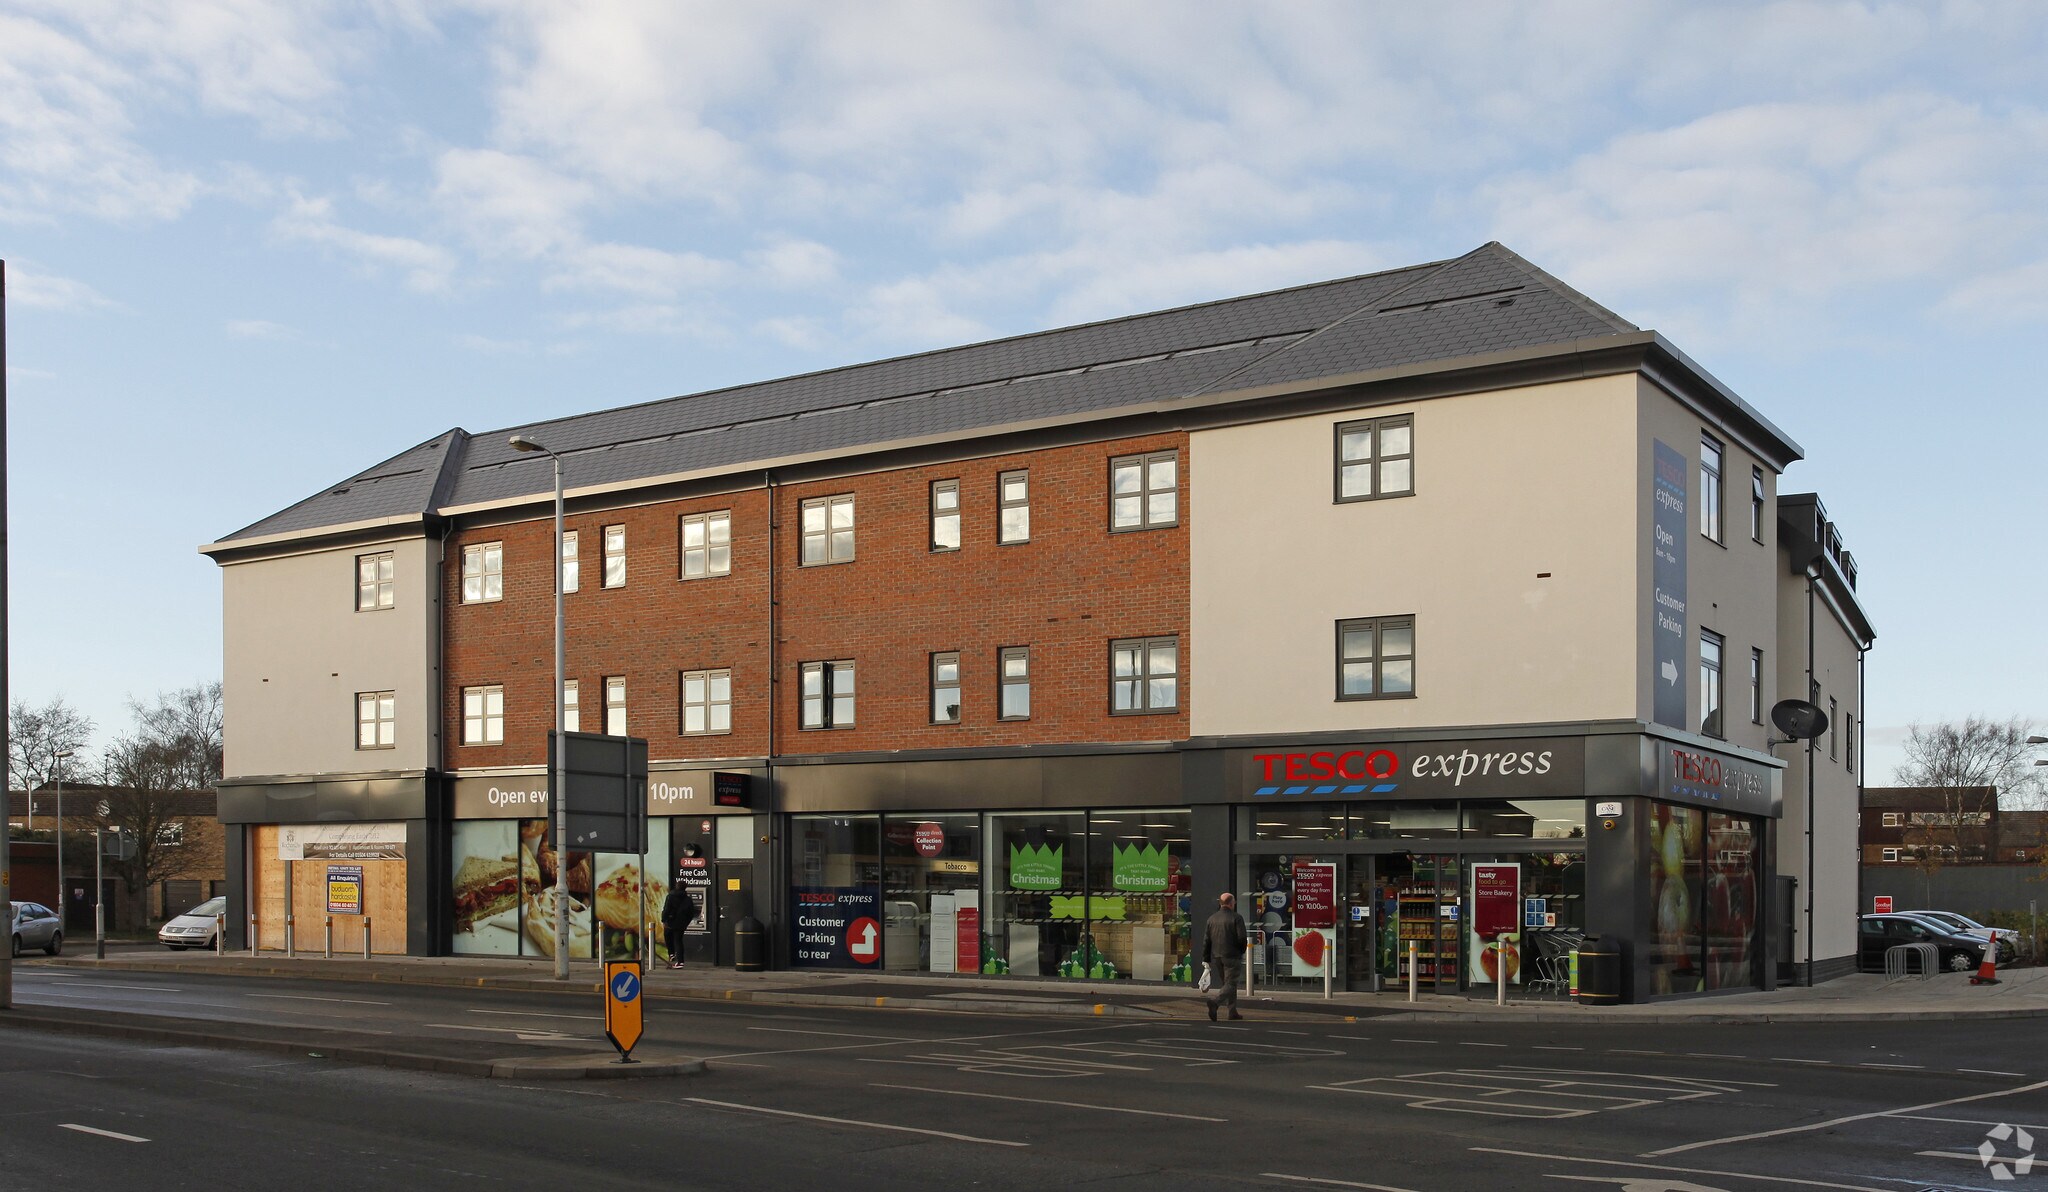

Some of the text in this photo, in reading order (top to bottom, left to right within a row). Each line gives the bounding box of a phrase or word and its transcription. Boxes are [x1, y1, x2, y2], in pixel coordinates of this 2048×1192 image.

[1656, 488, 1683, 513] express
[1656, 524, 1674, 546] Open
[1655, 587, 1685, 613] Customer
[1658, 611, 1682, 638] Parking
[1253, 749, 1552, 786] TESCO express
[1671, 749, 1764, 799] TESCO express
[488, 787, 526, 807] Open
[650, 783, 693, 803] 10pm
[693, 869, 708, 877] Cash
[945, 862, 967, 870] Tobacco
[1012, 873, 1060, 885] Christmas
[1115, 874, 1166, 886] Christmas
[799, 893, 873, 905] TESCO express
[799, 916, 845, 927] Customer
[799, 932, 836, 945] Parking
[799, 949, 831, 959] to rear
[857, 1038, 1347, 1078] CLEAR
[1305, 1065, 1779, 1118] KEEP
